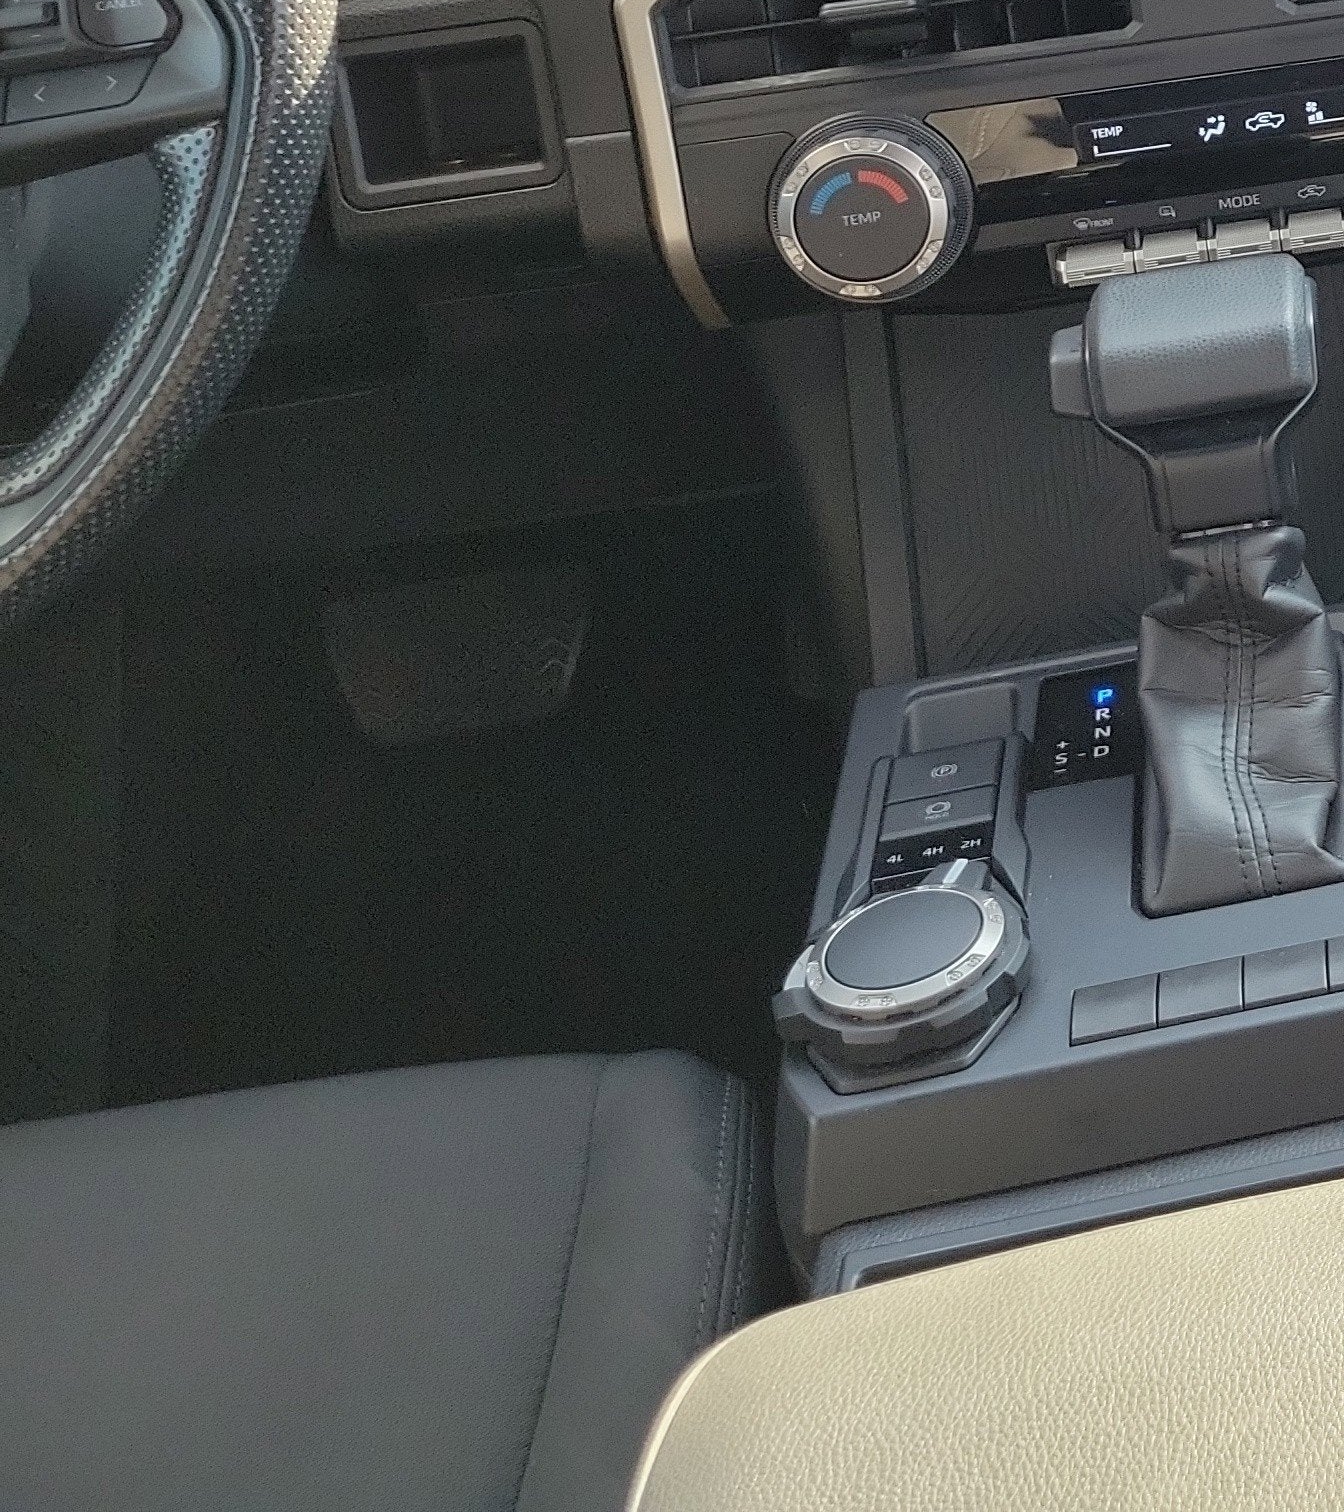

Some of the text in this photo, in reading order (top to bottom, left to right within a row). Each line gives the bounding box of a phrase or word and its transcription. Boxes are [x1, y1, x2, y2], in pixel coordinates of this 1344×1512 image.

[1091, 124, 1124, 140] TEMP
[1218, 192, 1262, 211] MODE
[841, 210, 881, 228] TEMP
[1097, 688, 1114, 704] P
[1095, 707, 1111, 721] R
[1094, 725, 1111, 740] N
[1055, 752, 1068, 765] S
[1093, 745, 1110, 758] D
[922, 845, 944, 857] 4H
[960, 838, 982, 850] 2H
[886, 854, 904, 864] 4L
